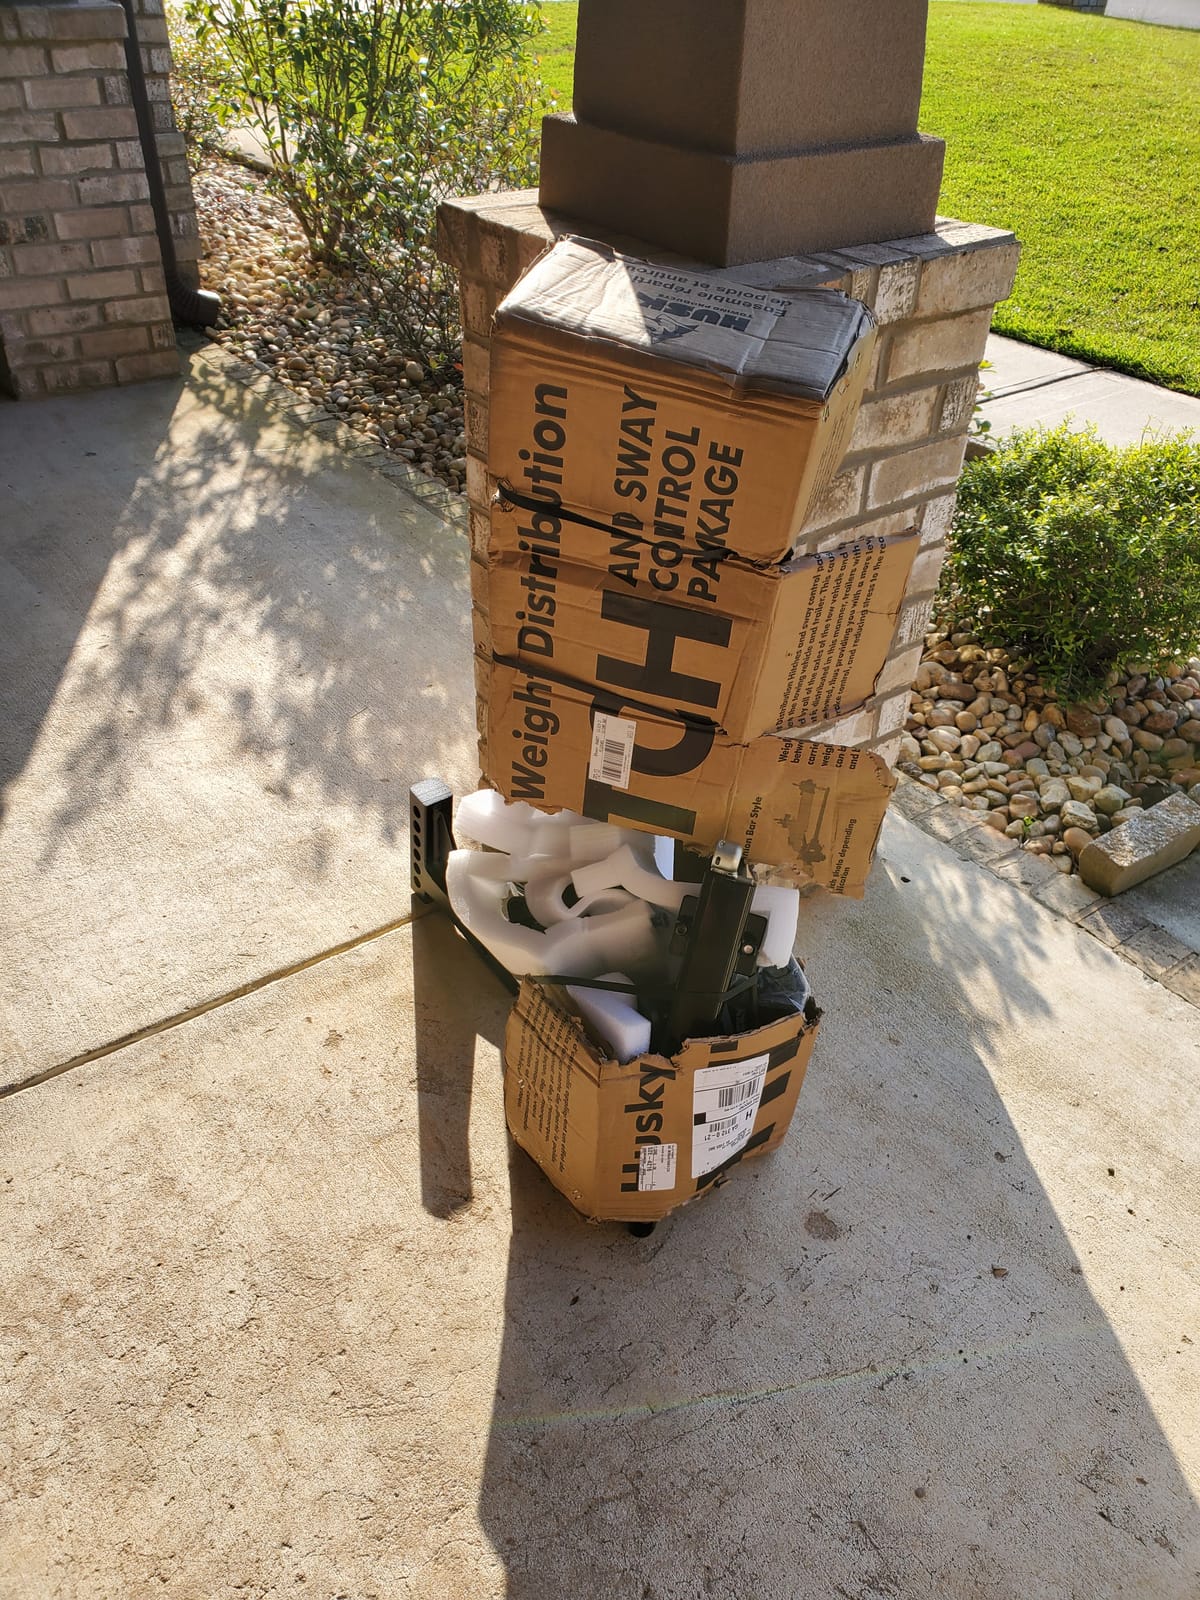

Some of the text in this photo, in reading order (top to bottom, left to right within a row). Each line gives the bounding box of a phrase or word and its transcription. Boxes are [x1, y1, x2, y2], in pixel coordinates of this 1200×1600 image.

[693, 281, 710, 291] et
[716, 286, 766, 303] poids
[658, 294, 752, 318] TOWING PRODUCTS
[698, 292, 787, 318] Ensemble
[771, 298, 792, 307] de
[608, 385, 658, 587] AND SWAY
[648, 426, 701, 592] CONTROL
[516, 383, 568, 657] Distribution
[687, 441, 744, 602] PAKAGE
[838, 552, 848, 571] and
[849, 544, 861, 566] with
[873, 556, 885, 570] the
[859, 556, 872, 579] more
[869, 573, 878, 582] to
[807, 575, 820, 605] control
[819, 575, 831, 595] This
[830, 573, 844, 604] vehicle
[840, 568, 857, 599] trailers
[849, 589, 862, 608] with
[862, 584, 876, 608] stress
[801, 608, 814, 629] sway
[812, 596, 825, 625] trailer.
[824, 607, 835, 622] tow
[831, 601, 848, 637] manner,
[845, 609, 856, 626] you
[809, 626, 818, 643] and
[820, 623, 830, 638] the
[851, 609, 868, 647] reducing
[797, 631, 807, 648] and
[818, 640, 826, 648] of
[824, 638, 835, 654] this
[834, 627, 852, 667] providing
[787, 650, 802, 680] Hitches
[800, 646, 813, 674] vehicle
[812, 649, 824, 671] axles
[822, 656, 832, 665] in
[847, 649, 857, 665] and
[807, 673, 817, 685] the
[812, 666, 830, 707] distributed
[828, 668, 839, 685] thus
[837, 666, 852, 694] control,
[792, 675, 807, 701] towing
[805, 686, 814, 695] of
[775, 681, 794, 726] Distribution
[788, 702, 797, 715] the
[801, 696, 811, 706] all
[835, 753, 845, 768] can
[849, 754, 859, 769] and
[750, 796, 762, 818] Style
[746, 820, 756, 836] Bar
[838, 819, 856, 857] depending
